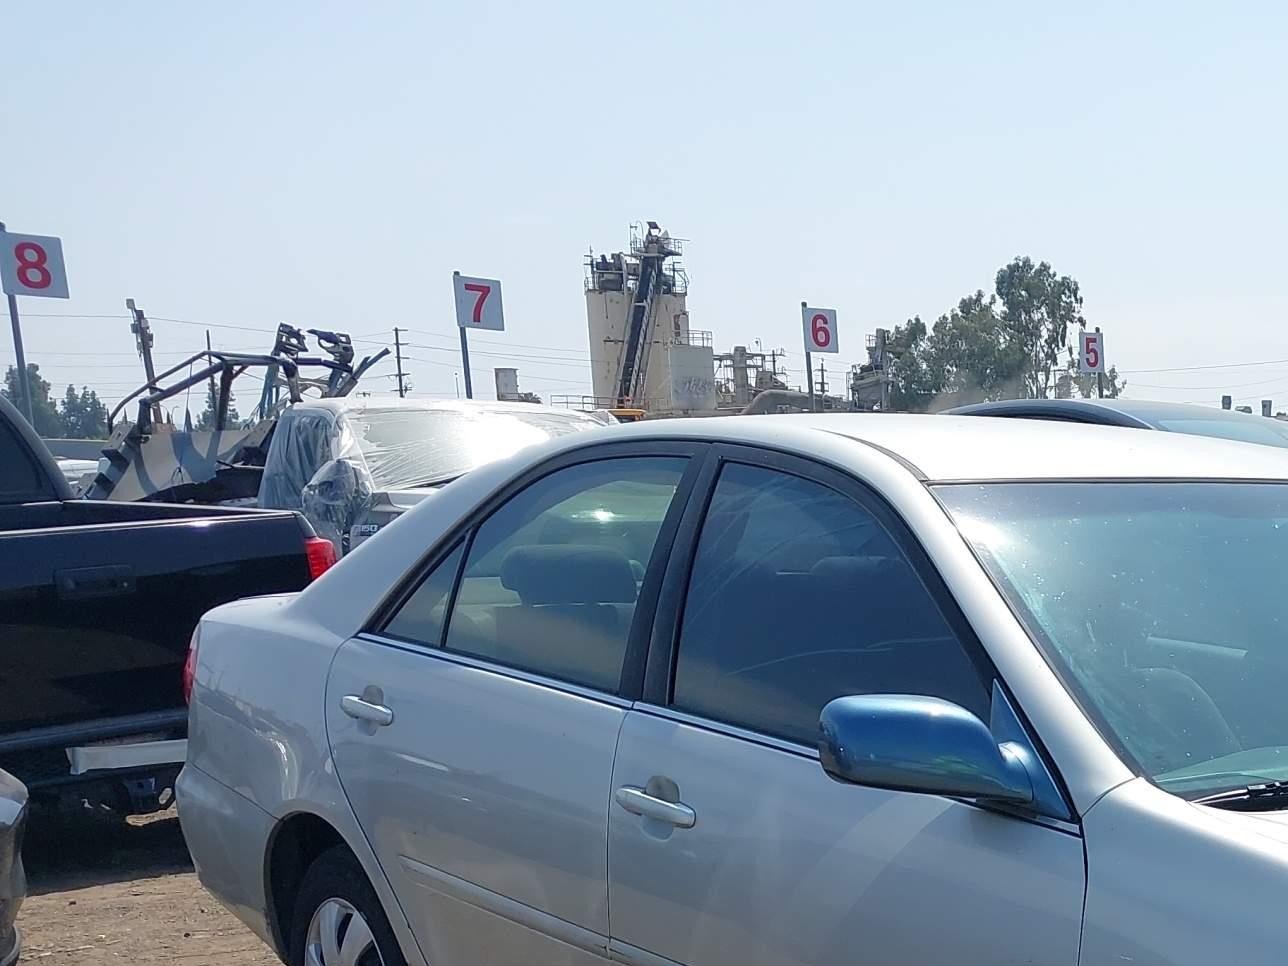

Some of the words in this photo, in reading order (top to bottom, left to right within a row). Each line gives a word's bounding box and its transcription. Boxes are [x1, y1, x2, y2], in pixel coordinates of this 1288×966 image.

[13, 241, 52, 290] 8
[464, 283, 491, 323] 7
[811, 313, 831, 348] 6
[1085, 336, 1099, 368] 5
